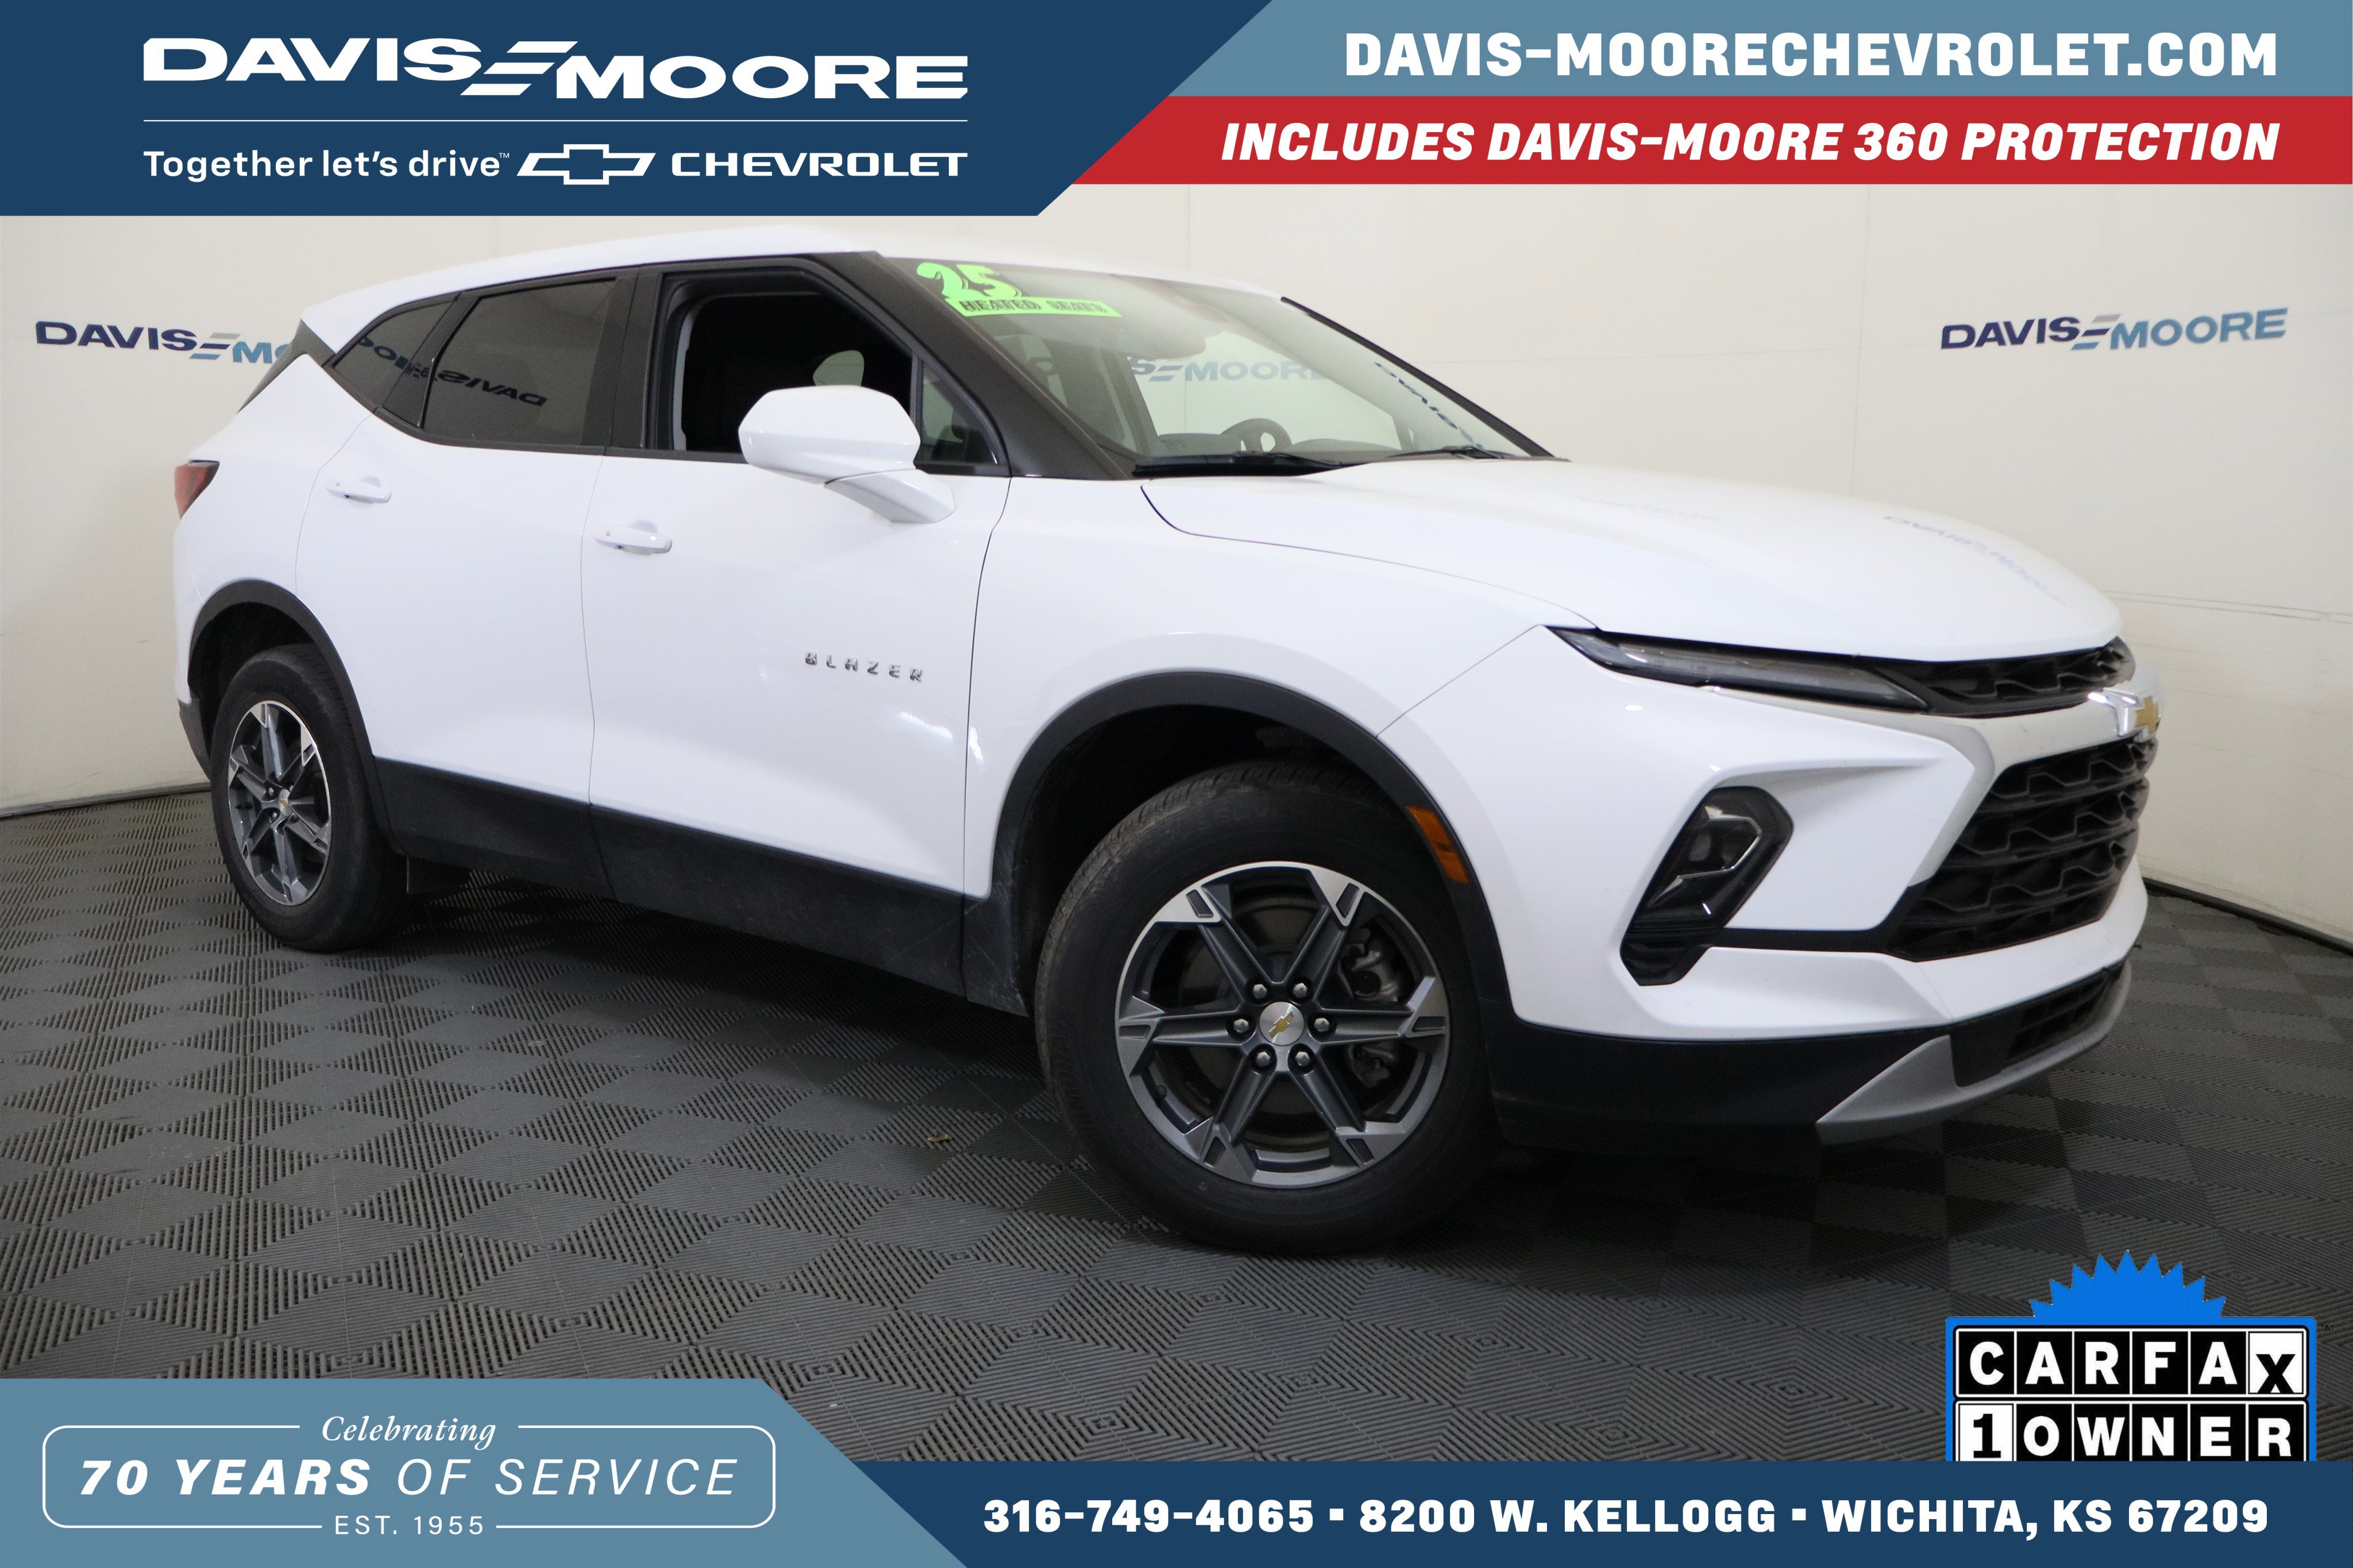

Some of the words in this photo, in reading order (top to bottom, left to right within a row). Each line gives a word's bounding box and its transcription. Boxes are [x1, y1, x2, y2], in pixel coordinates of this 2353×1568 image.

[916, 262, 1022, 298] 25
[958, 299, 1041, 312] HEATED
[36, 320, 197, 351] DAVIS
[804, 651, 923, 683] BLAZER
